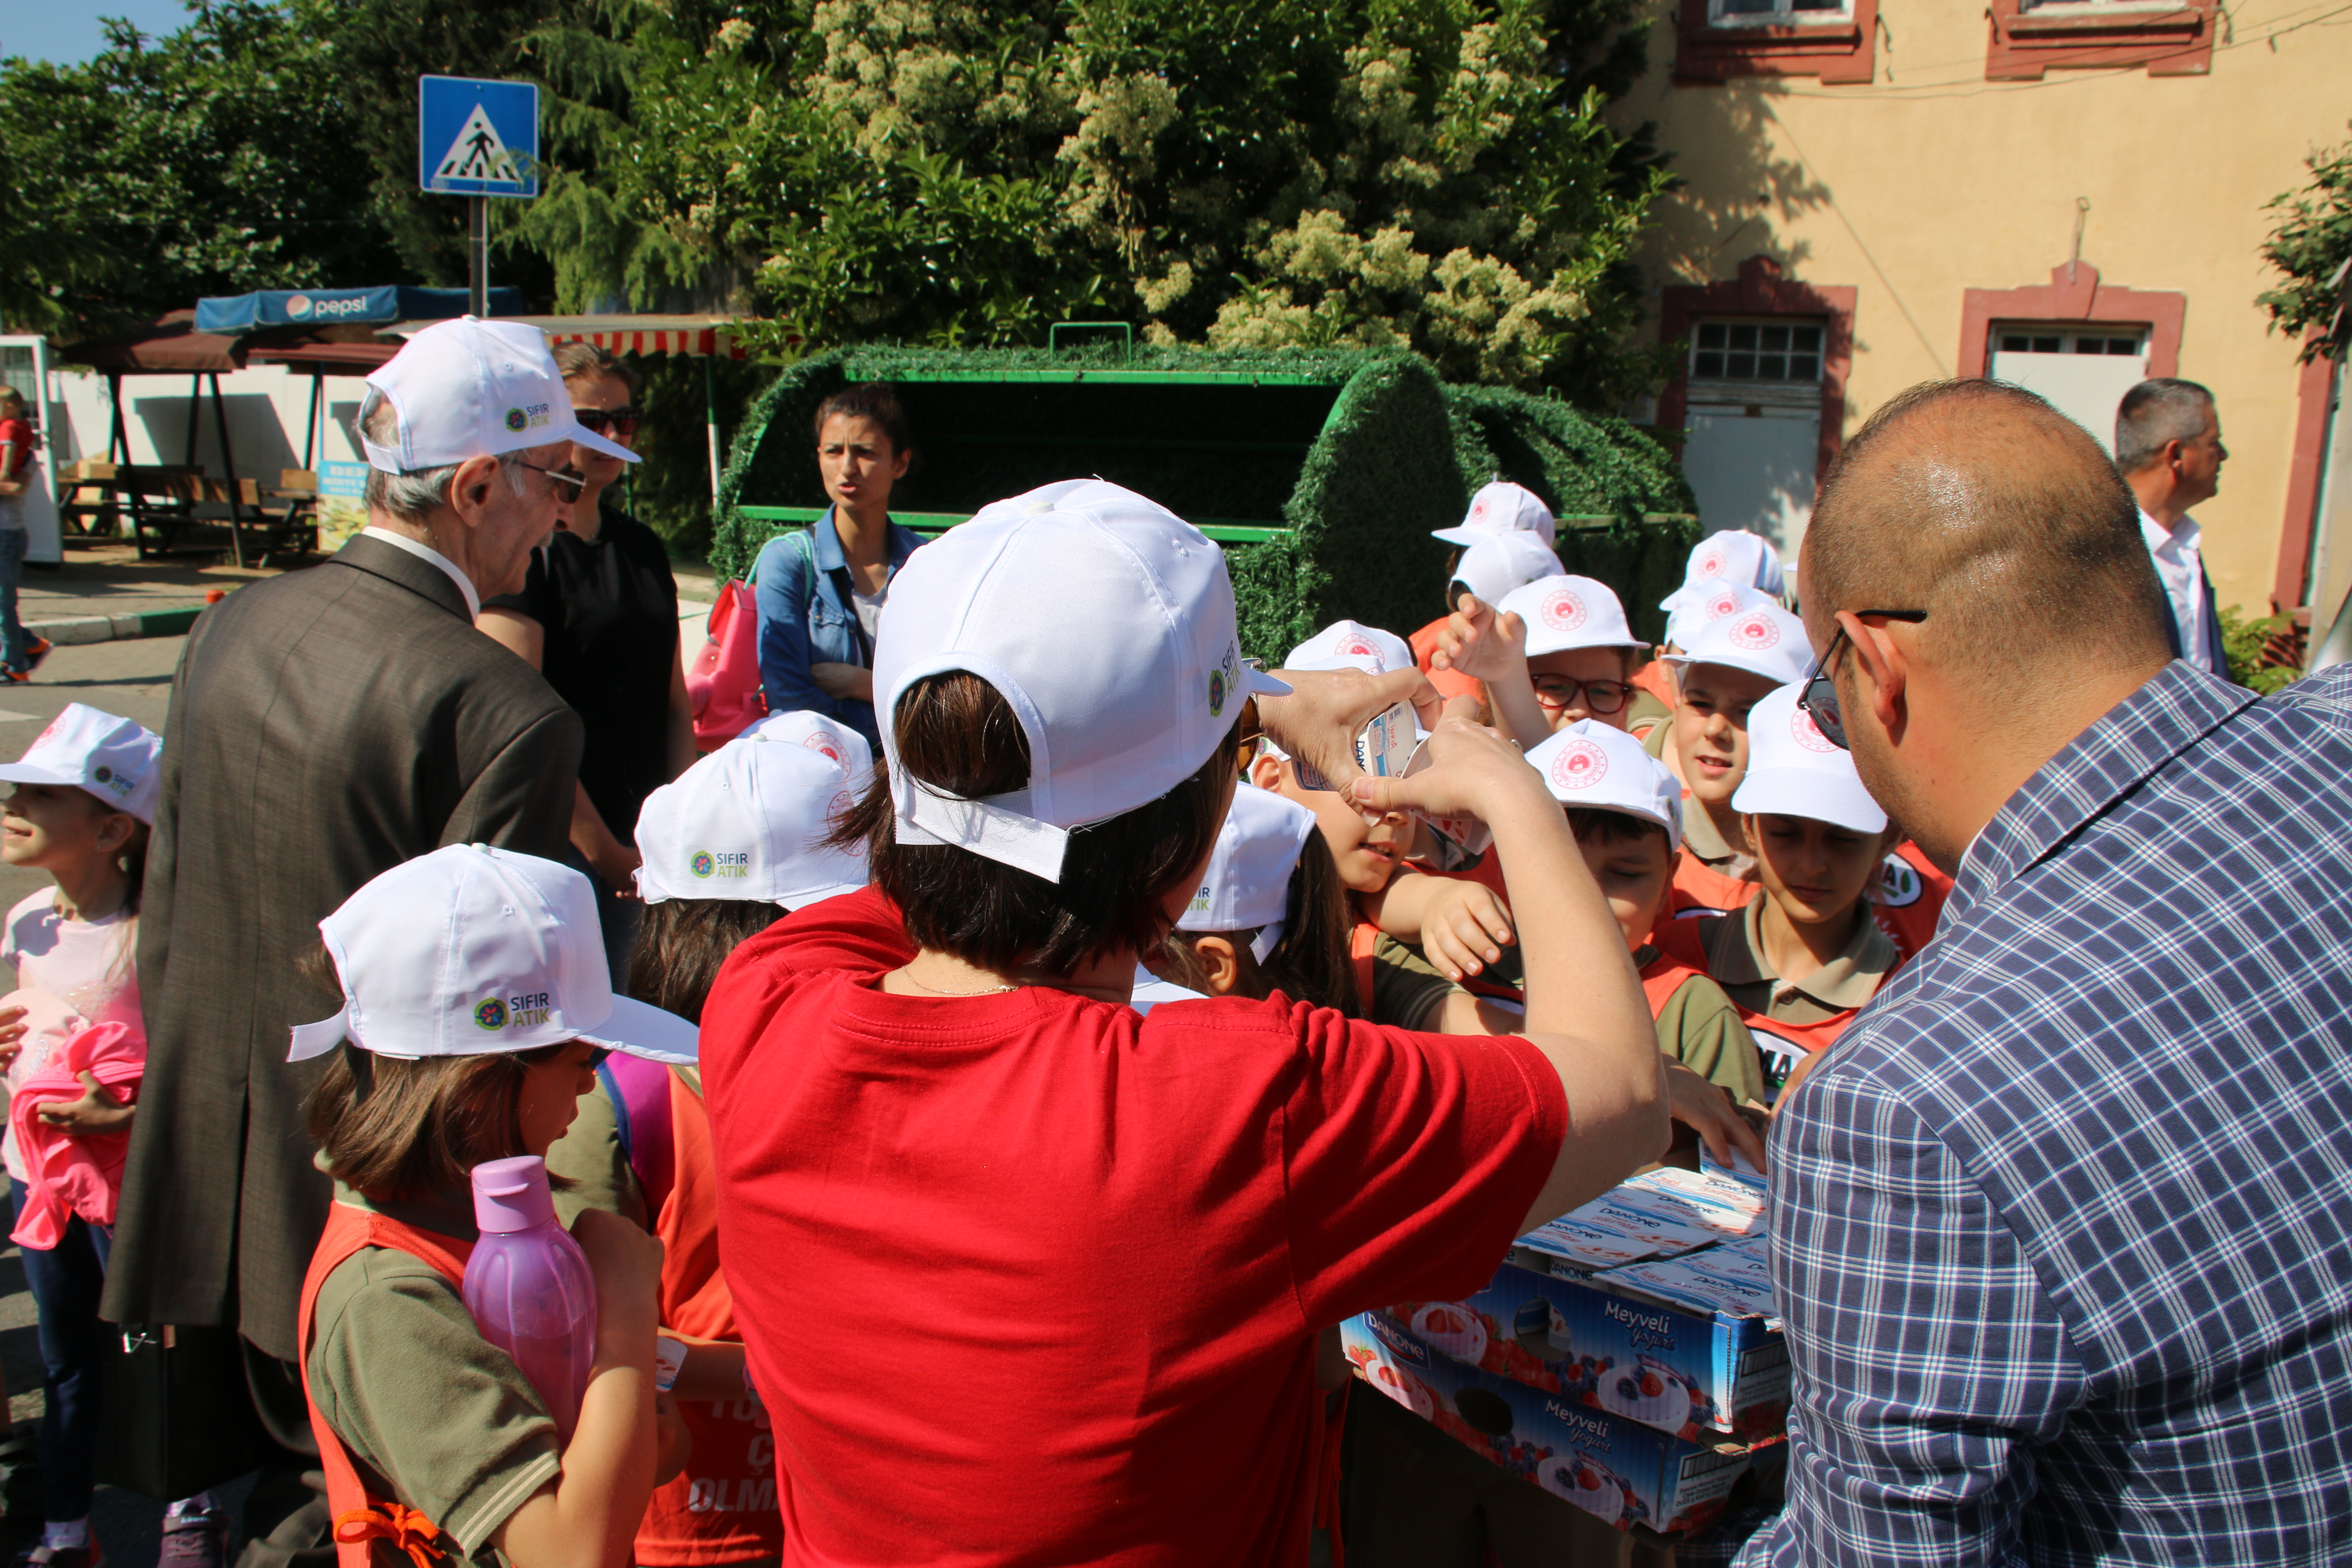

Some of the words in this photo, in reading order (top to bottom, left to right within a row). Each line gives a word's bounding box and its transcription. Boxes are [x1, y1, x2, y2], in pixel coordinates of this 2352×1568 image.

[315, 296, 368, 318] pepsi
[526, 403, 549, 416] SIFIR
[530, 414, 550, 428] ATIK
[1222, 640, 1235, 677] SIFIR
[1228, 658, 1240, 698] ATIK
[717, 853, 748, 864] SIFIR
[717, 865, 748, 878] ATIK
[1187, 899, 1210, 911] TIK
[510, 993, 550, 1011] SIFIR
[513, 1007, 551, 1027] ATIK
[1604, 1300, 1671, 1334] Meyveli
[1546, 1399, 1609, 1438] Meyveli
